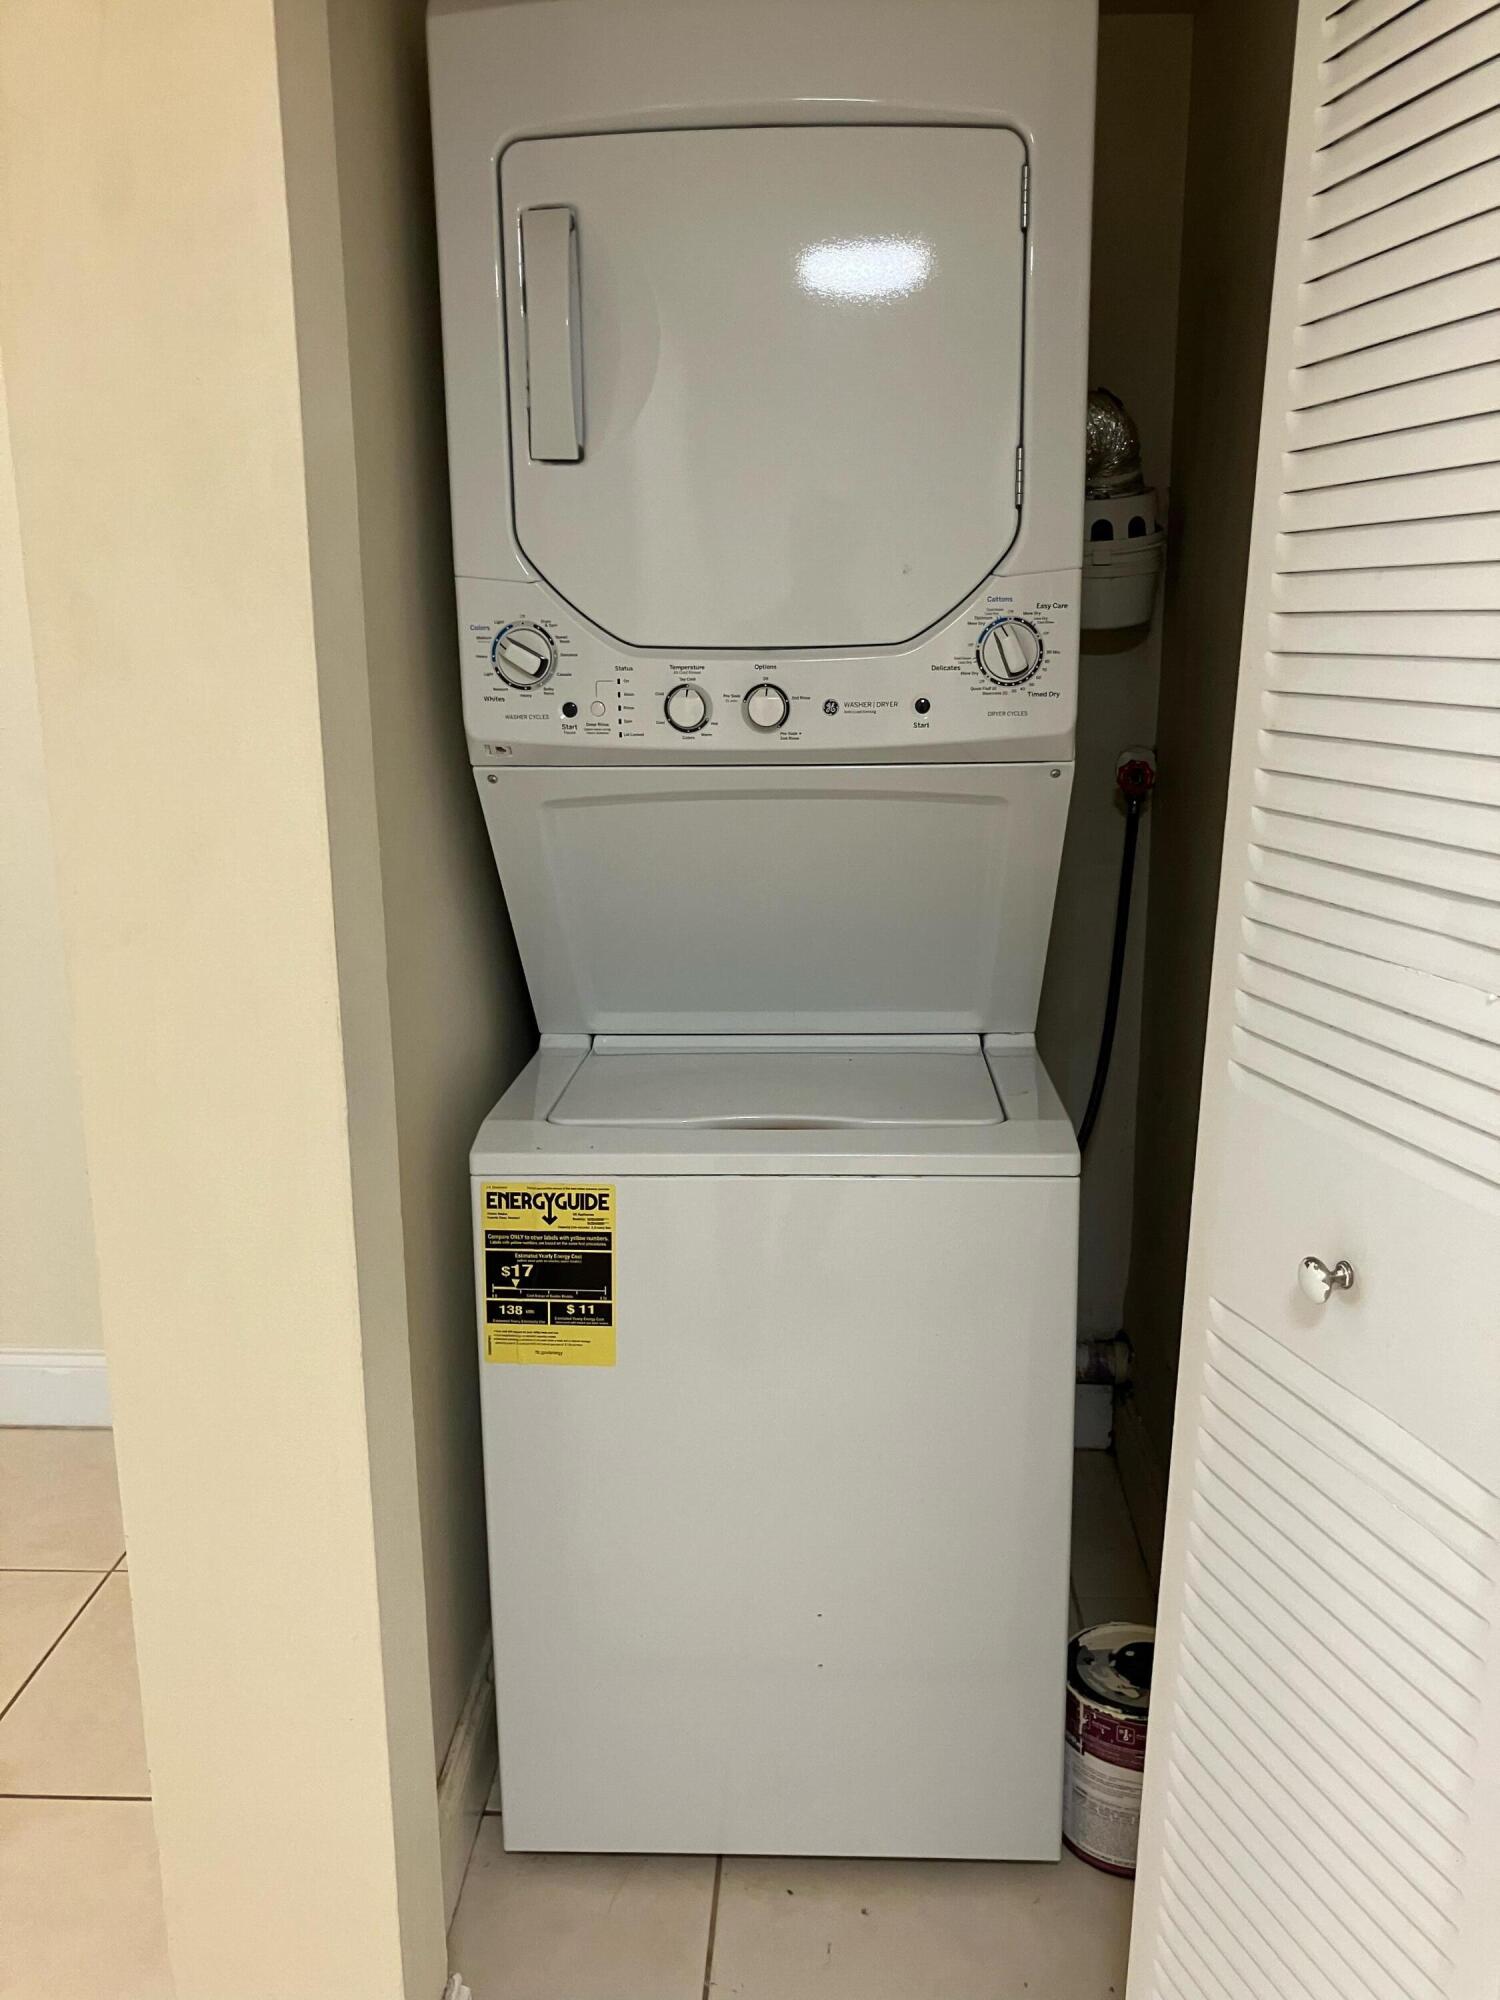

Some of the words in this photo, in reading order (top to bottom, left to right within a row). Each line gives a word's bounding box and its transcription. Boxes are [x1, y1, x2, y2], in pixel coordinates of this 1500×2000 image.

[1048, 690, 1061, 698] Dry
[486, 1191, 609, 1211] ENERGYGUIDE
[500, 1263, 533, 1277] $17
[498, 1304, 522, 1314] 138
